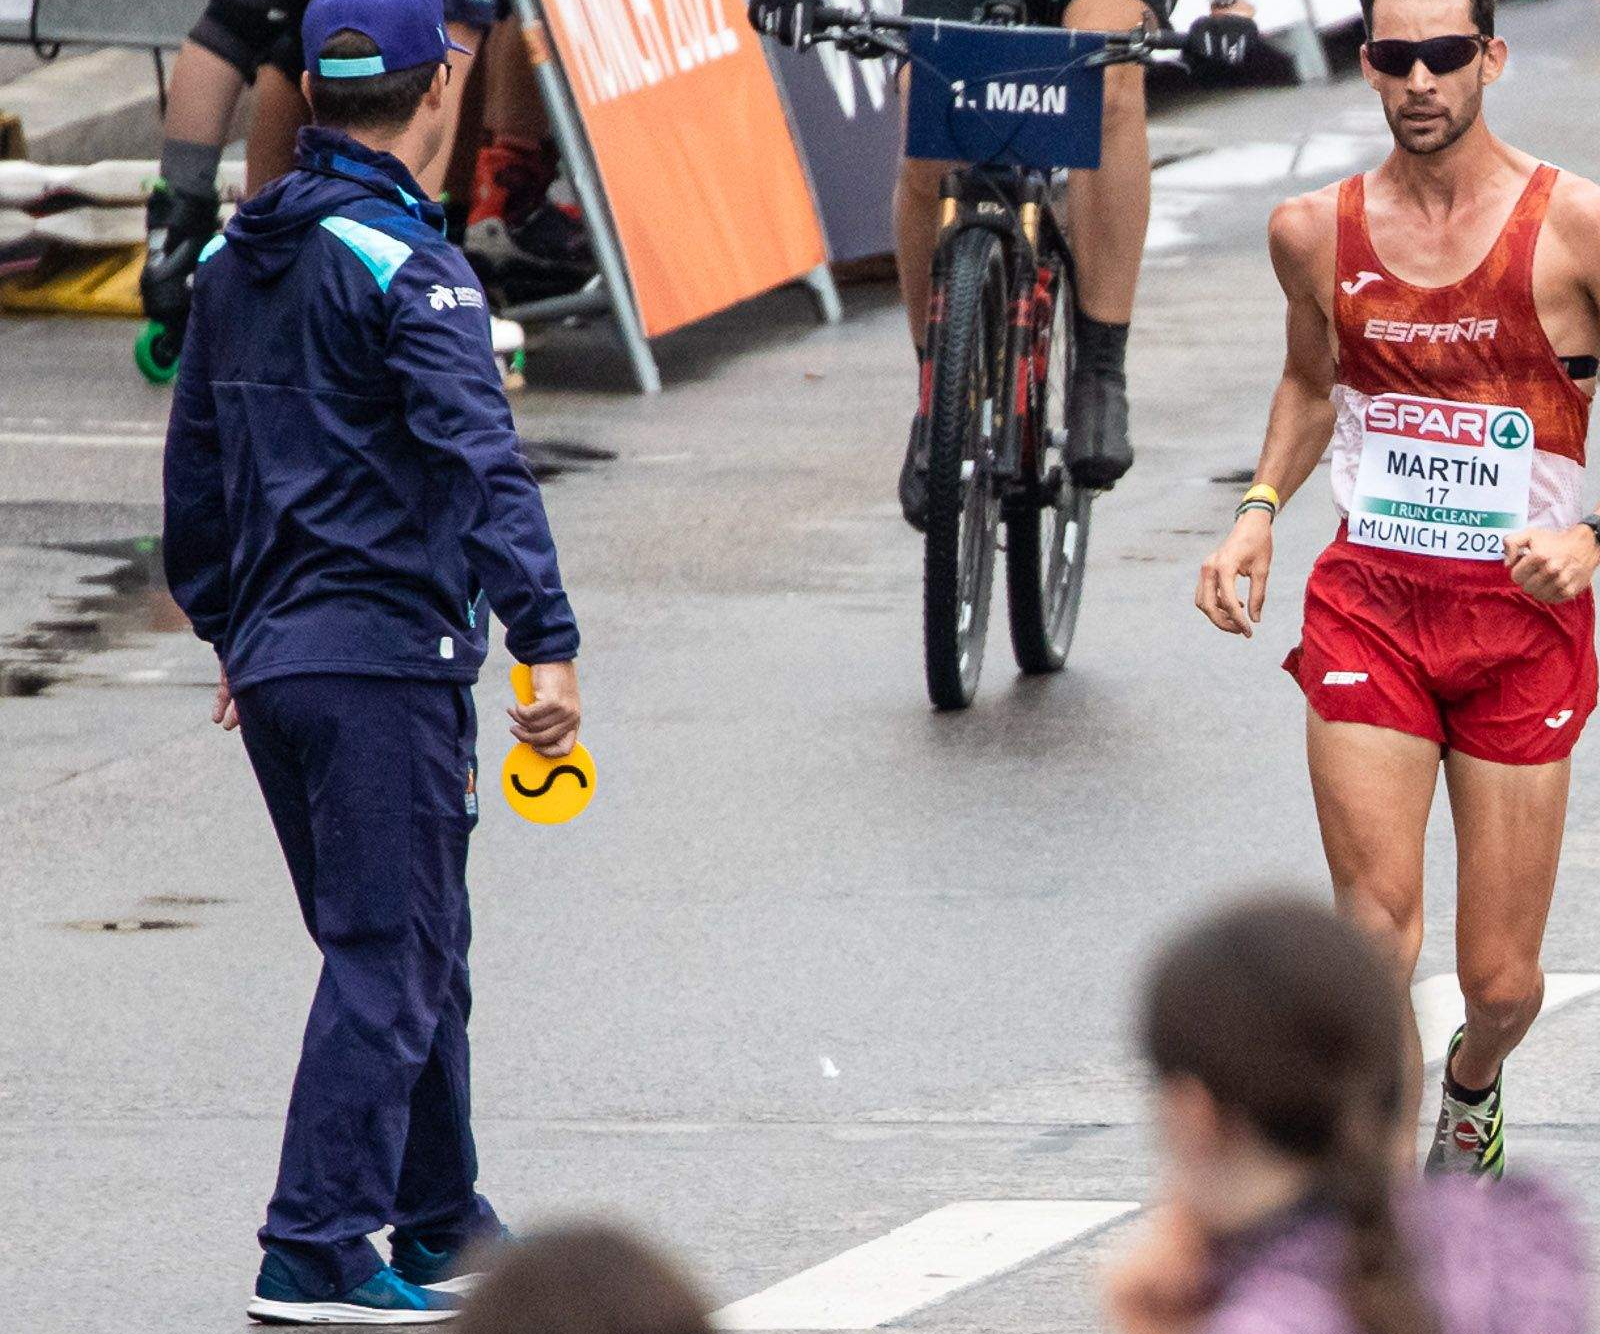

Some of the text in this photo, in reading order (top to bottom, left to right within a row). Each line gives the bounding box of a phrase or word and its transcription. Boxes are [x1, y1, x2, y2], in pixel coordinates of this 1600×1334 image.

[985, 81, 1067, 115] MAN
[1363, 317, 1498, 343] ESPAÑA
[1366, 400, 1484, 442] SPAR
[1386, 450, 1499, 487] MARTÍN
[1400, 504, 1428, 519] RUN
[1425, 486, 1450, 505] 17
[1359, 518, 1505, 555] MUNICH 202
